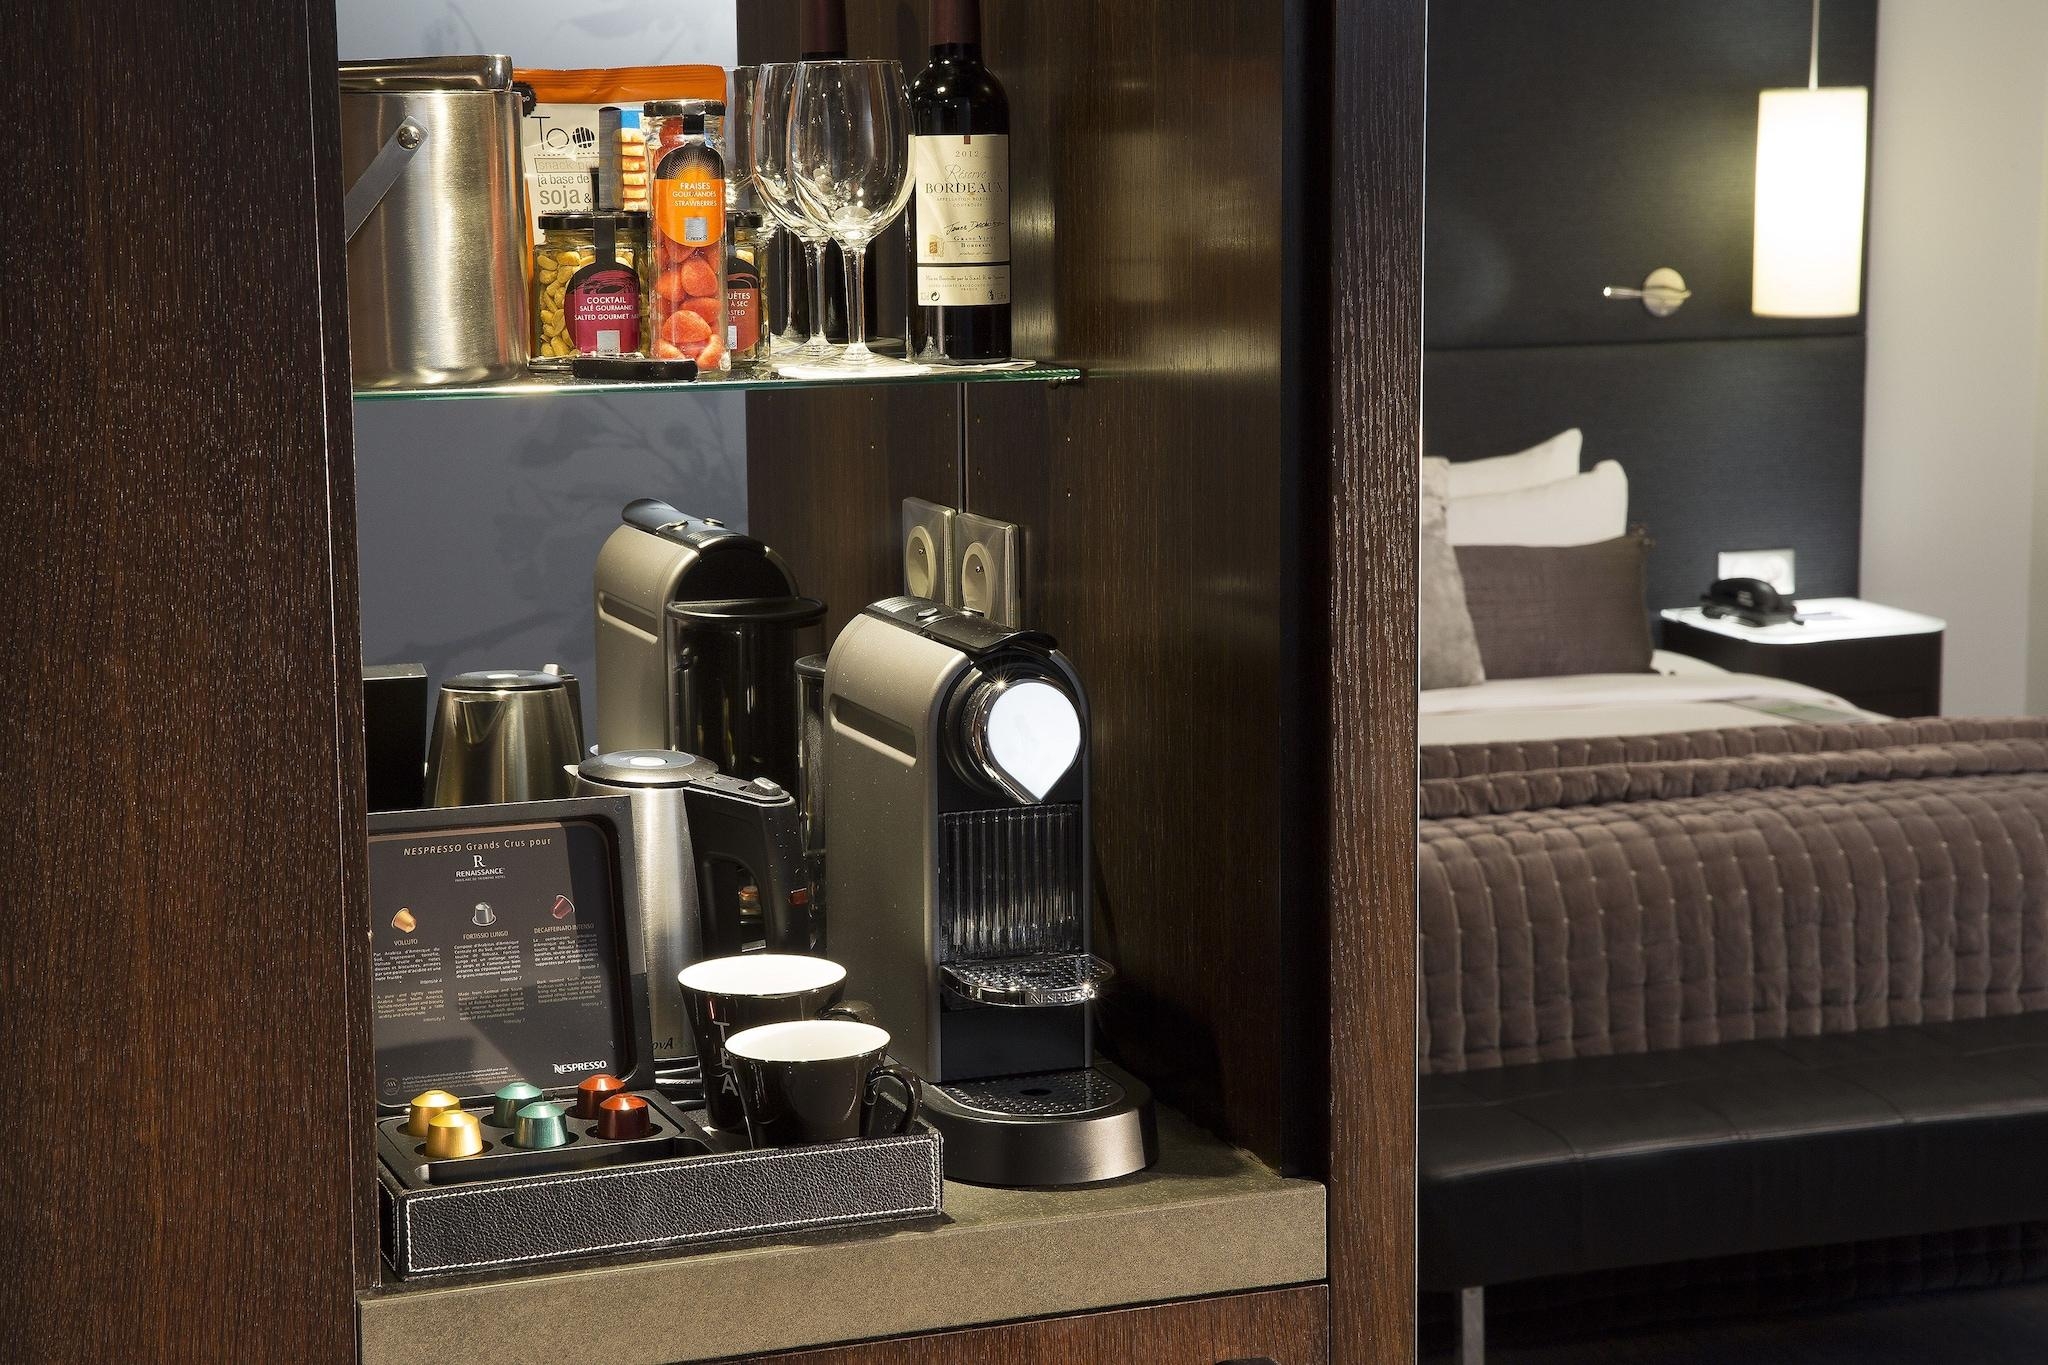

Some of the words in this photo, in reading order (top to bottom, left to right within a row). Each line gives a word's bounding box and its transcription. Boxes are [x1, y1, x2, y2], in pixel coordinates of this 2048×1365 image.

[550, 174, 574, 184] base
[577, 174, 590, 184] de
[925, 182, 1004, 194] BORDEAUX
[540, 186, 580, 208] soja
[584, 193, 592, 204] &
[403, 844, 462, 856] NESPRESSO
[466, 841, 500, 851] Grands
[504, 839, 525, 848] Crus
[530, 838, 551, 848] pour
[473, 855, 486, 867] R
[455, 868, 504, 877] RENAISSANCE
[534, 925, 571, 934] DECAFFEINATO
[713, 1021, 738, 1096] TEA
[552, 1060, 606, 1074] NESPRESSO
